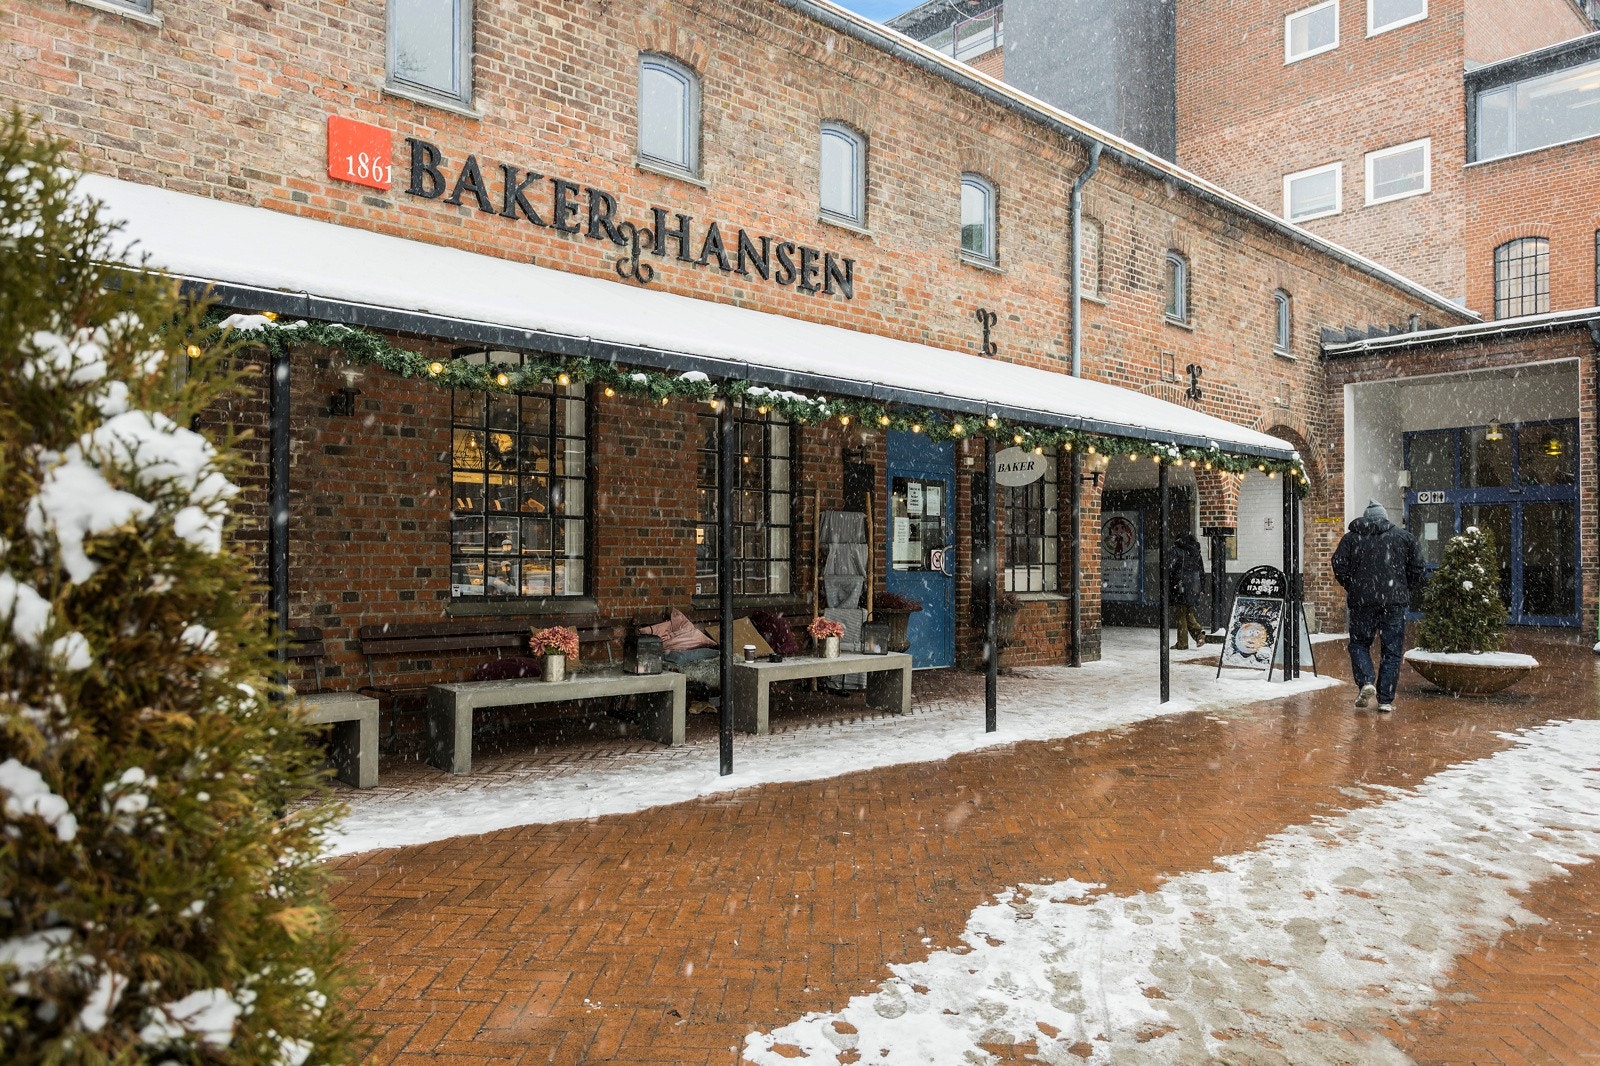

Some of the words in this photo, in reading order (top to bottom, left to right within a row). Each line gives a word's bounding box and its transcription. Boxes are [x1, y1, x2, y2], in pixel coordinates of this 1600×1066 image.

[345, 151, 393, 184] 1861
[404, 137, 628, 247] BAKER
[650, 207, 855, 300] HANSEN
[998, 460, 1035, 473] BAKER
